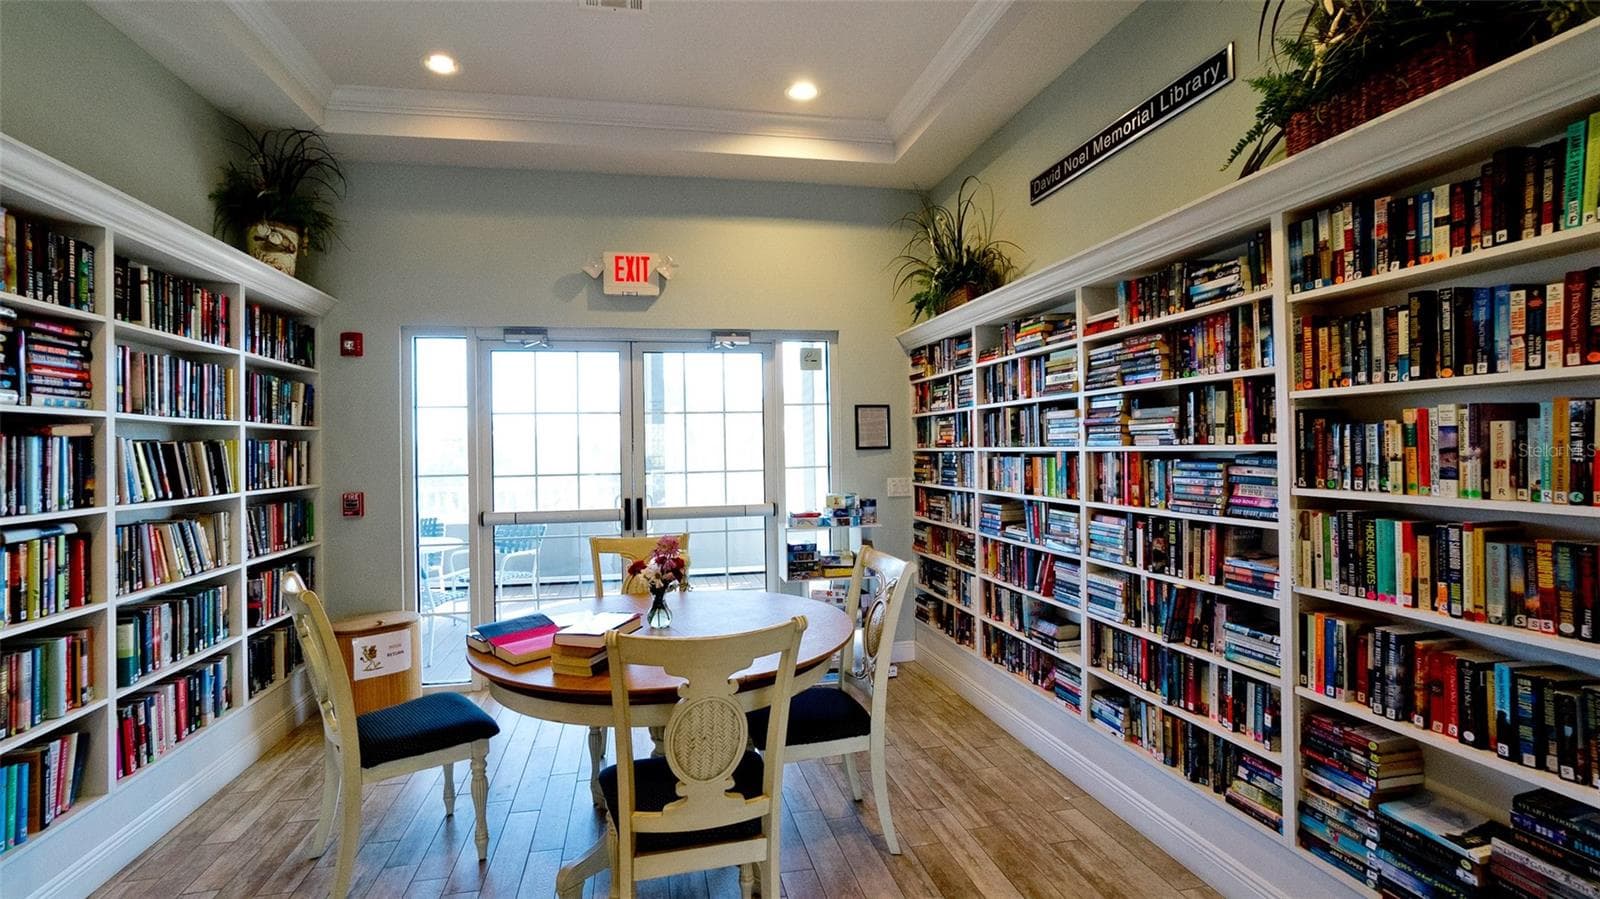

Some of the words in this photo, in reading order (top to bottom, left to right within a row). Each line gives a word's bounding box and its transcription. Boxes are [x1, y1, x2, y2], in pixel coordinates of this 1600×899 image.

[1033, 170, 1061, 195] David
[1063, 151, 1089, 175] Noel
[1093, 101, 1154, 156] Memorial
[1160, 60, 1221, 112] Library
[614, 255, 650, 283] EXIT
[1571, 439, 1584, 463] WOLF
[1366, 554, 1376, 584] KNIVES
[1537, 551, 1553, 588] SANDFORD
[1515, 615, 1523, 625] S
[1543, 621, 1551, 630] S
[1498, 746, 1507, 755] S
